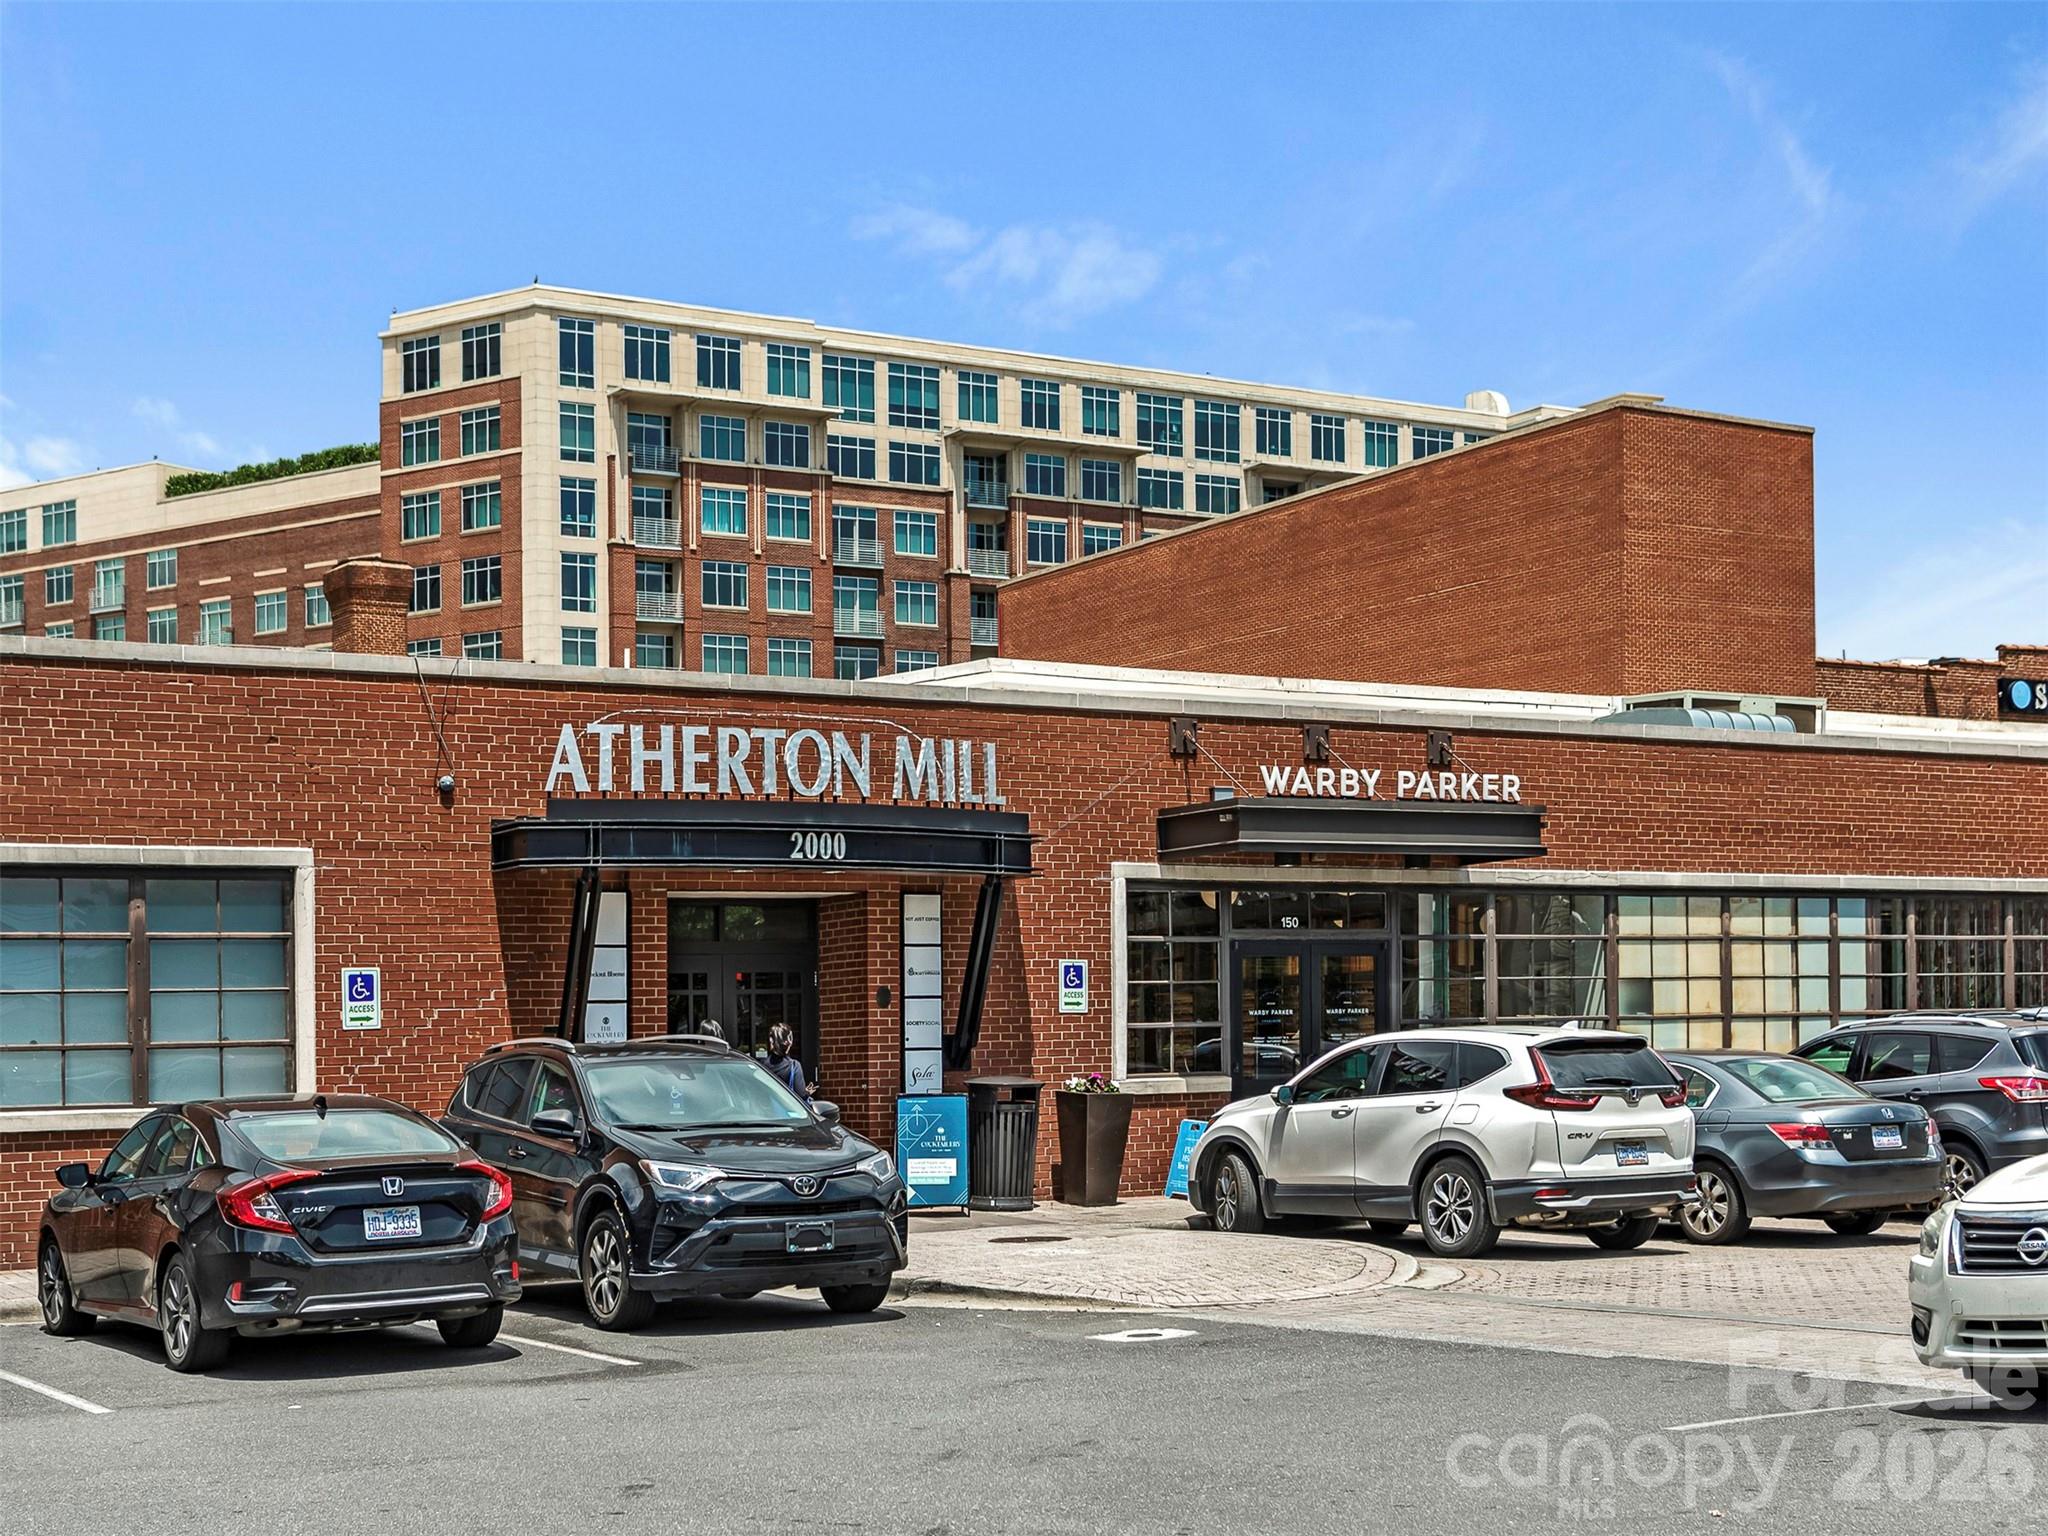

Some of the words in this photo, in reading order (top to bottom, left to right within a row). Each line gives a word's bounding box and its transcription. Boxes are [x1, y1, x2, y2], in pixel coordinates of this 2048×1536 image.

[546, 723, 871, 798] ATHERTON
[893, 736, 1007, 806] MILL
[1259, 765, 1381, 797] WARBY
[1397, 770, 1521, 802] PARKER
[790, 832, 846, 860] 2000
[1280, 917, 1299, 928] 150
[349, 1005, 375, 1013] ACCESS
[1567, 1132, 1593, 1140] CR-V
[292, 1205, 327, 1214] CIVIC
[367, 1209, 418, 1232] HDJ-9335
